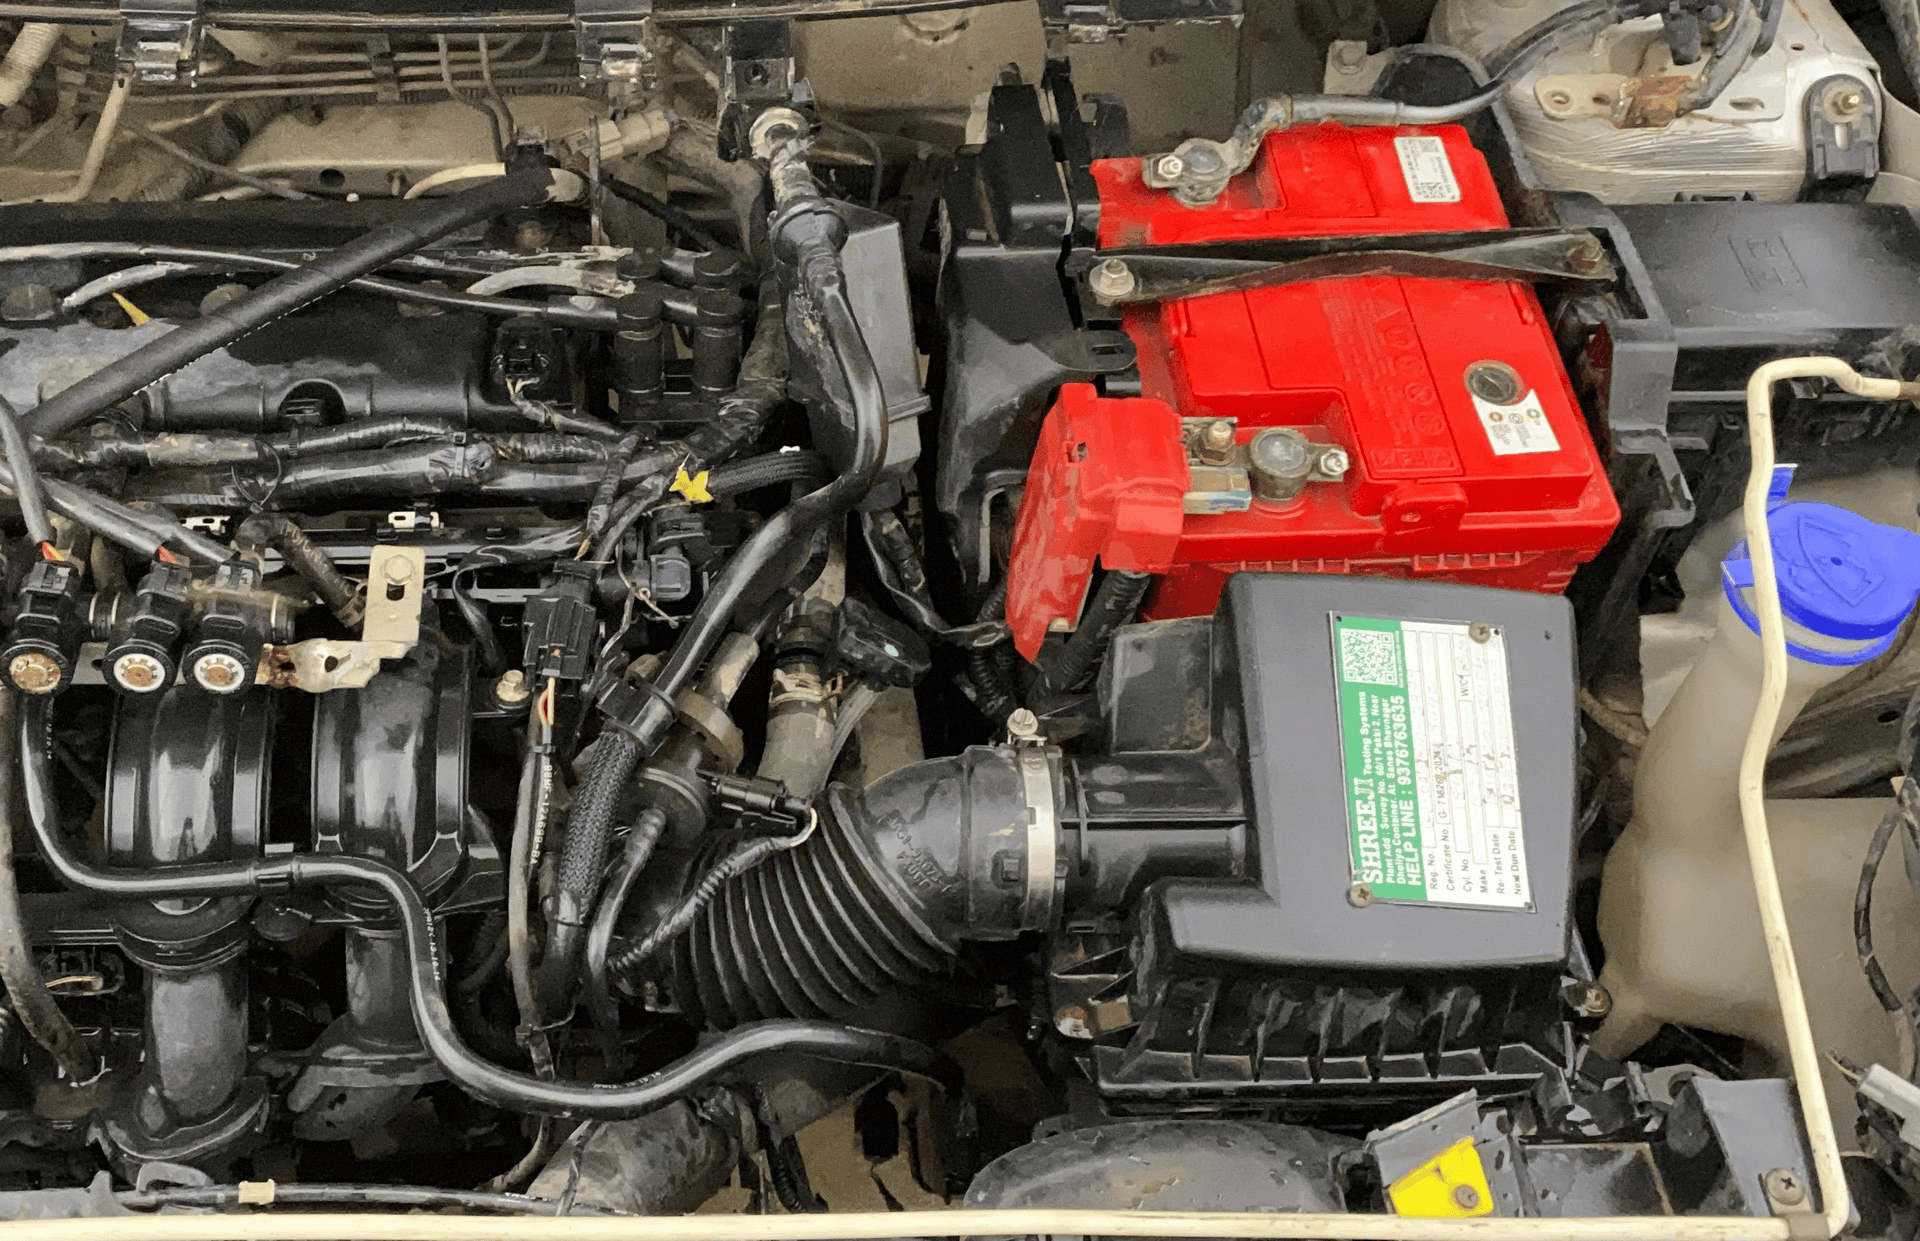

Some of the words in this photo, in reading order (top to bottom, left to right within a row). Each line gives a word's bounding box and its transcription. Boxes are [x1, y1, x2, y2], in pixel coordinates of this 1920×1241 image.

[1359, 691, 1371, 736] Systems
[1371, 694, 1380, 716] Near
[1382, 698, 1393, 748] Bhavnagar
[1390, 695, 1411, 785] 9376763635
[1362, 737, 1373, 776] Testing
[1377, 779, 1386, 794] No.
[1380, 796, 1389, 829] Survey
[1399, 800, 1416, 837] LINE
[1354, 777, 1384, 884] SHREEJI
[1492, 834, 1501, 855] Date
[1382, 837, 1392, 857] Add
[1386, 858, 1395, 883] Plant
[1404, 841, 1422, 886] HELP
[1444, 844, 1455, 891] Certificate
[1494, 857, 1503, 875] Test
[1510, 854, 1520, 872] Due
[1480, 870, 1488, 894] Make
[1512, 874, 1522, 896] Next
